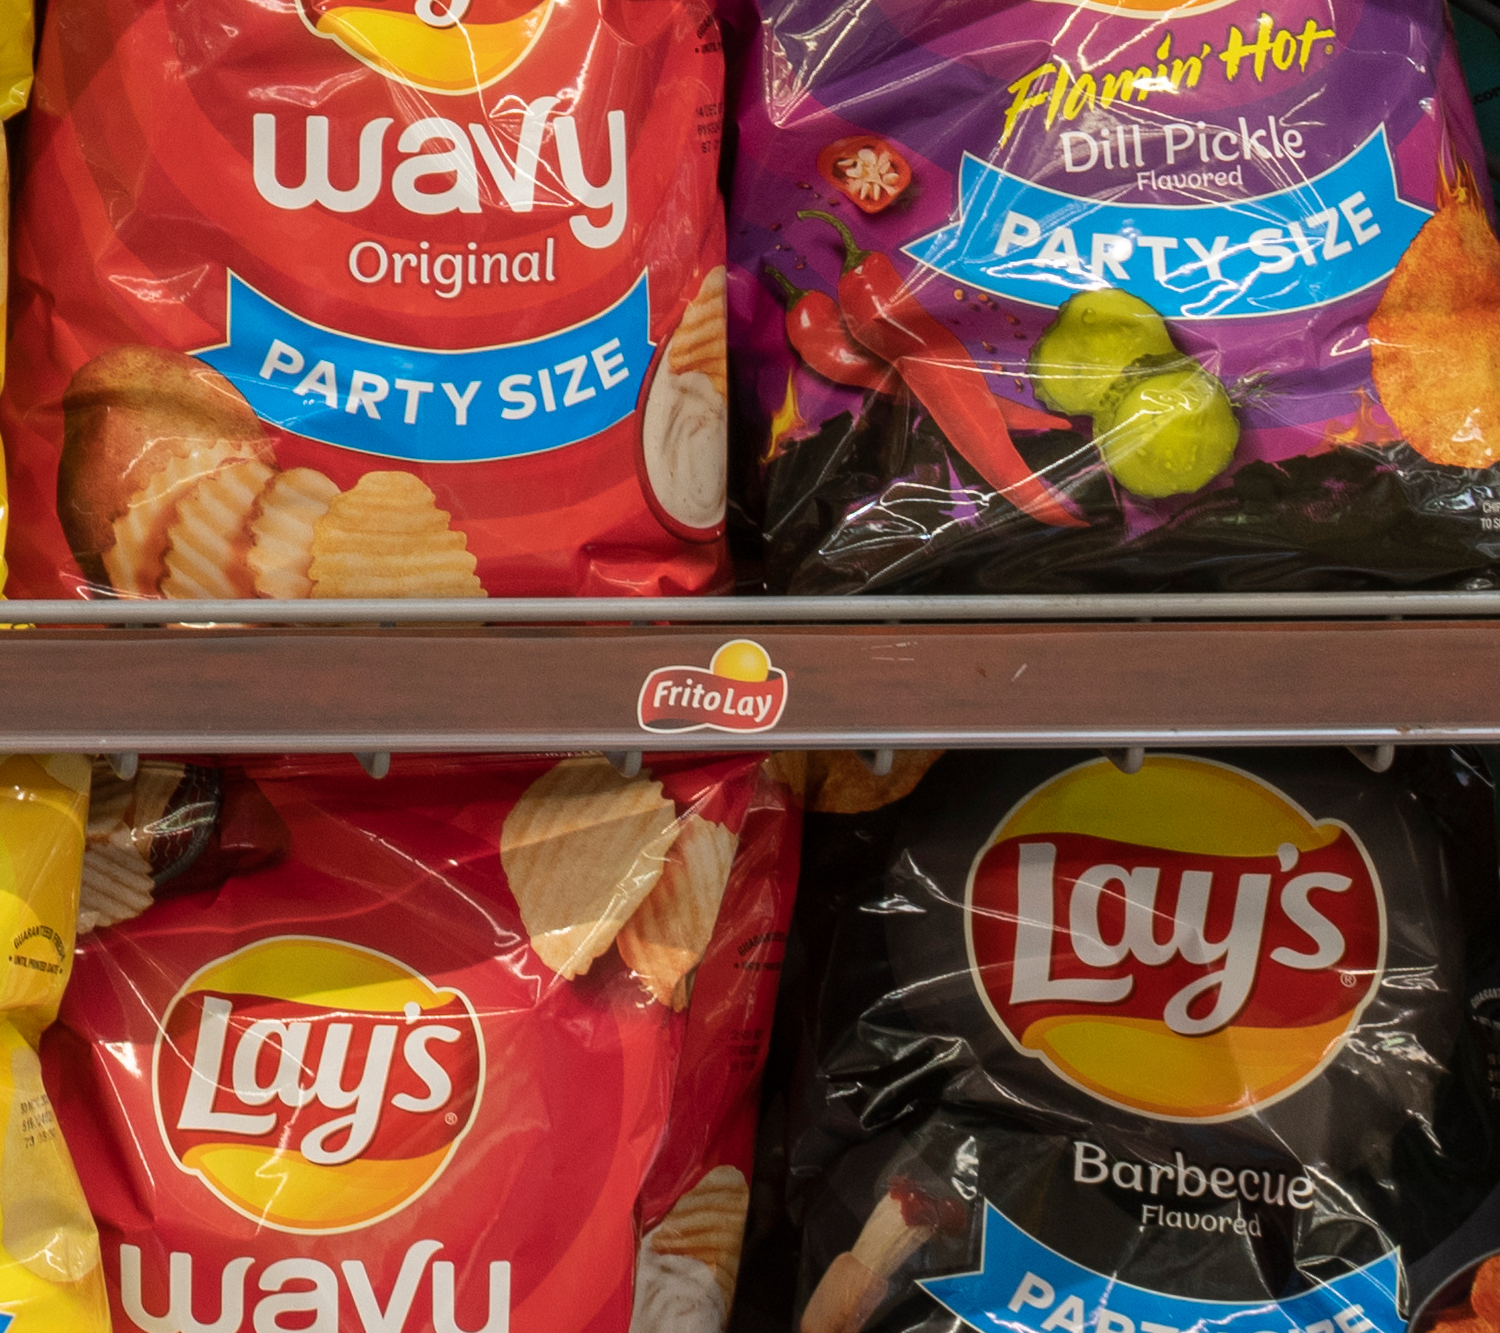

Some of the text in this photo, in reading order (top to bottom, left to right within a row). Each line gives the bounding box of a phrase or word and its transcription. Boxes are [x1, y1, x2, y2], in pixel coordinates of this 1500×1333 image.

[1220, 13, 1331, 81] Hot
[254, 94, 627, 249] wavy
[1061, 117, 1306, 174] Dill Pickle
[1136, 164, 1243, 193] Flavored
[349, 240, 556, 299] Original
[996, 189, 1381, 283] PARTY SIZE
[258, 337, 630, 427] PARTY SIZE
[1009, 842, 1354, 1036] Lay's
[177, 1002, 462, 1164] Lay's
[1073, 1140, 1317, 1212] Barbecue
[1141, 1202, 1263, 1238] Flavored
